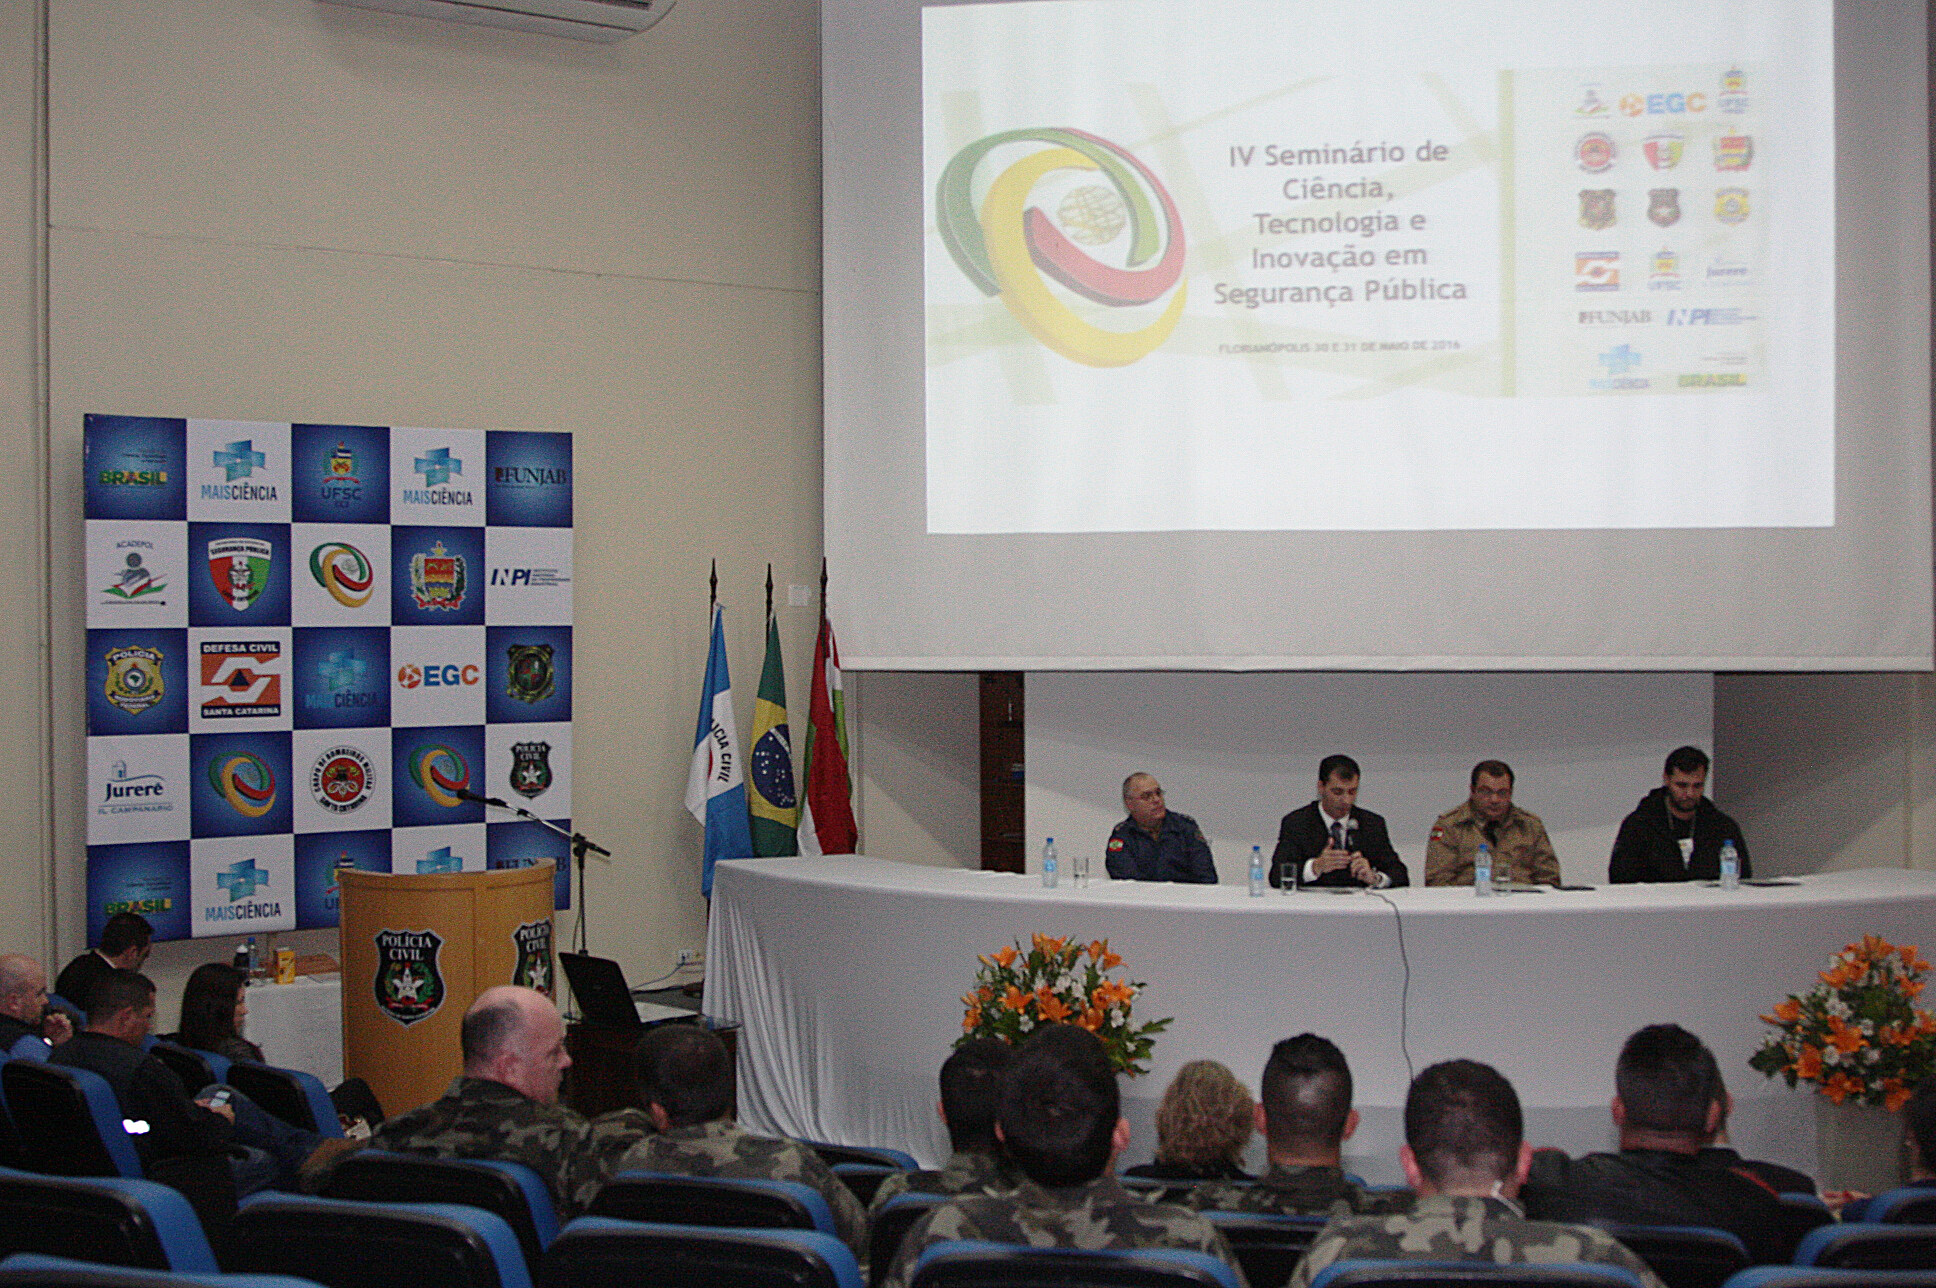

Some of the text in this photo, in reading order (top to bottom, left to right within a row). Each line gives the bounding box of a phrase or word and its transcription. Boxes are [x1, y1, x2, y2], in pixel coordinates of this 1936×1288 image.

[1647, 93, 1706, 114] EGC
[1230, 140, 1449, 167] IV Seminário de
[1283, 176, 1394, 201] Ciência,
[1253, 210, 1427, 237] Tecnologia e
[1253, 244, 1427, 273] Inovação em
[1214, 278, 1467, 309] Segurança Pública
[1332, 342, 1340, 352] E
[1361, 341, 1376, 352] DE
[1379, 341, 1409, 351] MAIO
[1413, 340, 1427, 351] DE
[101, 470, 167, 486] BRASIL
[201, 481, 277, 501] MAISCIÊNCIA
[322, 487, 361, 500] UFSC
[403, 487, 473, 506] MAISCIÊNCIA
[203, 643, 279, 654] DEFESA CIVIL
[424, 664, 479, 686] EGC
[203, 707, 279, 717] SANTA CATARINA
[710, 717, 732, 783] ICIA CIVIL
[105, 782, 163, 802] Jureré
[205, 900, 281, 922] MAISCIÊNCIA
[382, 933, 432, 948] POLÍCIA
[389, 948, 424, 961] CIVIL
